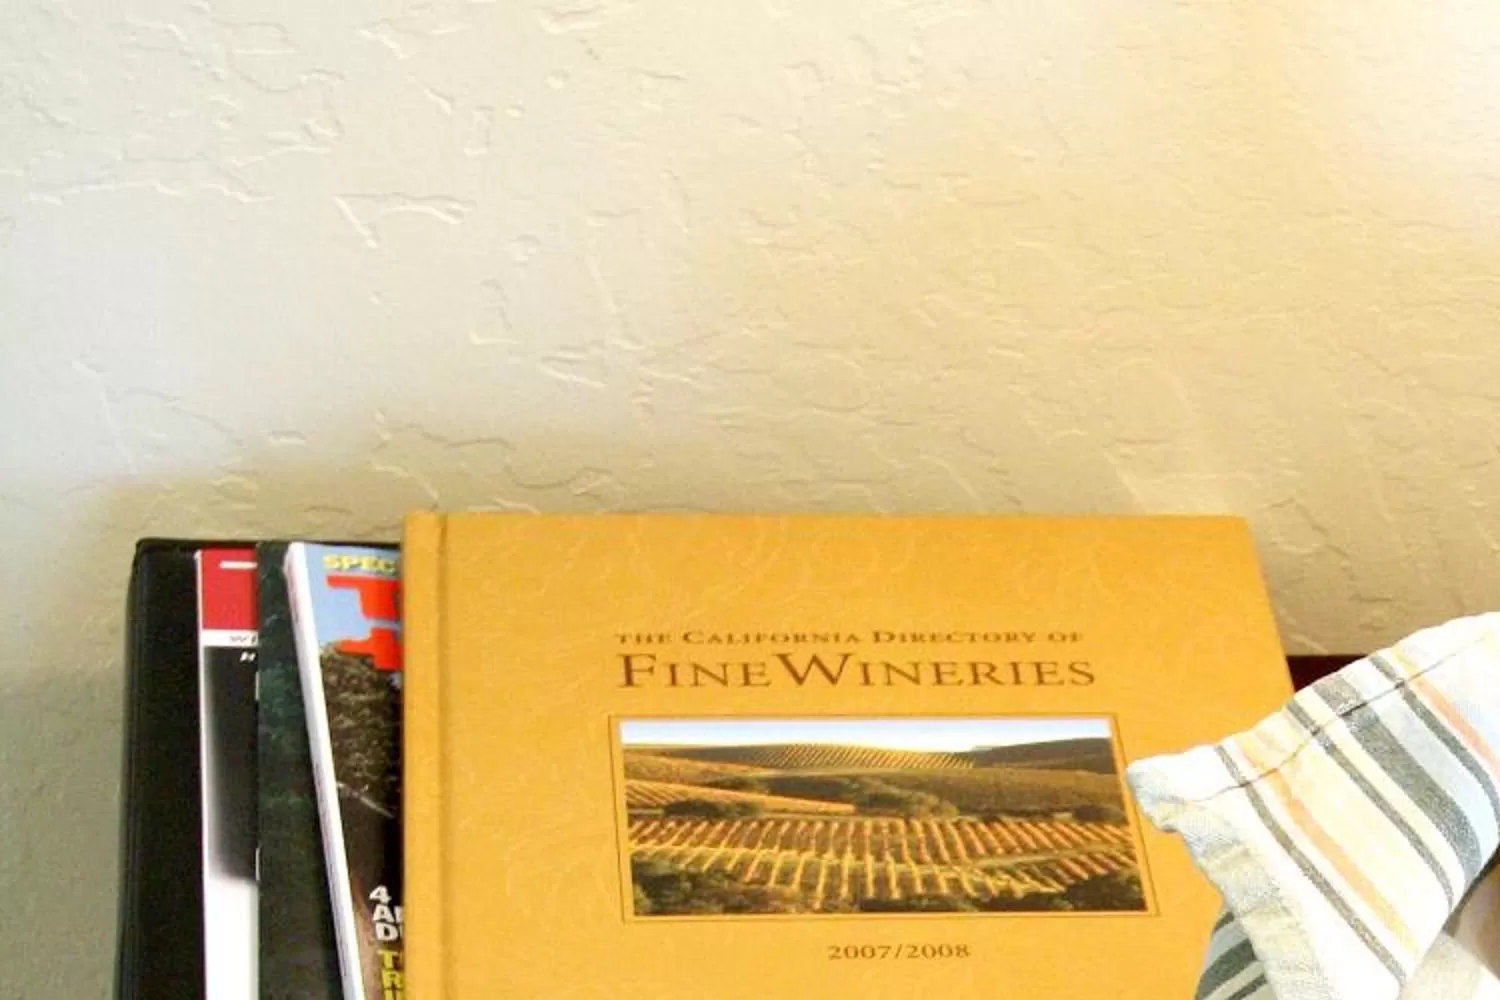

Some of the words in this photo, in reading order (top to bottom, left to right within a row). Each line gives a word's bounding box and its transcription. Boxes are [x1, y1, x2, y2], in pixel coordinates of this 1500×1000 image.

[616, 632, 671, 644] THE
[682, 631, 861, 645] CALIFORNIA
[872, 630, 1036, 644] DIRECTORY
[1047, 631, 1084, 643] OF
[827, 943, 972, 961] 2007/2008
